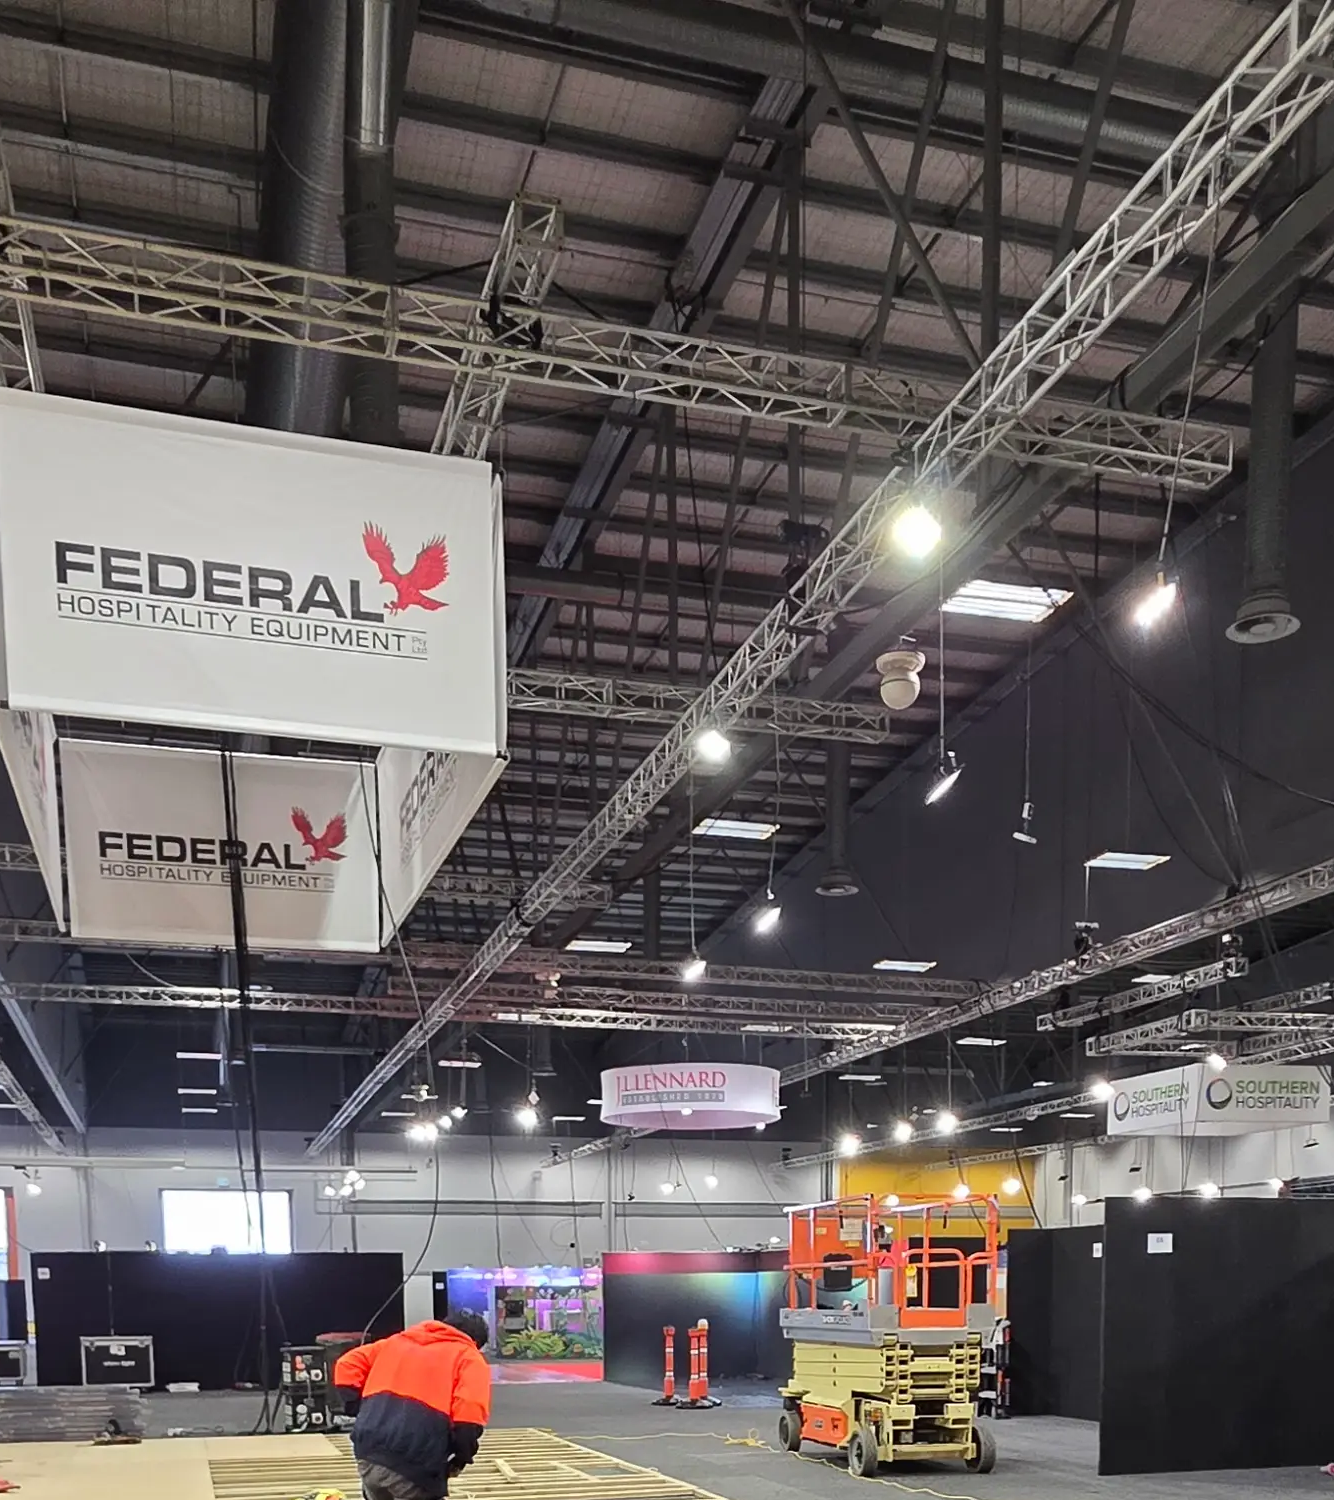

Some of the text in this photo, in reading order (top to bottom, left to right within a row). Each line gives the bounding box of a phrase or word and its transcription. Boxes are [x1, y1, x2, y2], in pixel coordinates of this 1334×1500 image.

[55, 541, 385, 623] FEDERAL
[57, 593, 406, 652] HOSPITALITY EQUIPMENT
[98, 831, 307, 870] FEDERAL
[99, 863, 213, 882] HOSPITALITY
[221, 873, 320, 888] EUIPMENT
[1131, 1081, 1190, 1104] SOUTHERN
[1235, 1080, 1320, 1094] SOUTHERN
[1131, 1096, 1190, 1118] HOSPITALITY
[1235, 1096, 1320, 1109] HOSPITALITY
